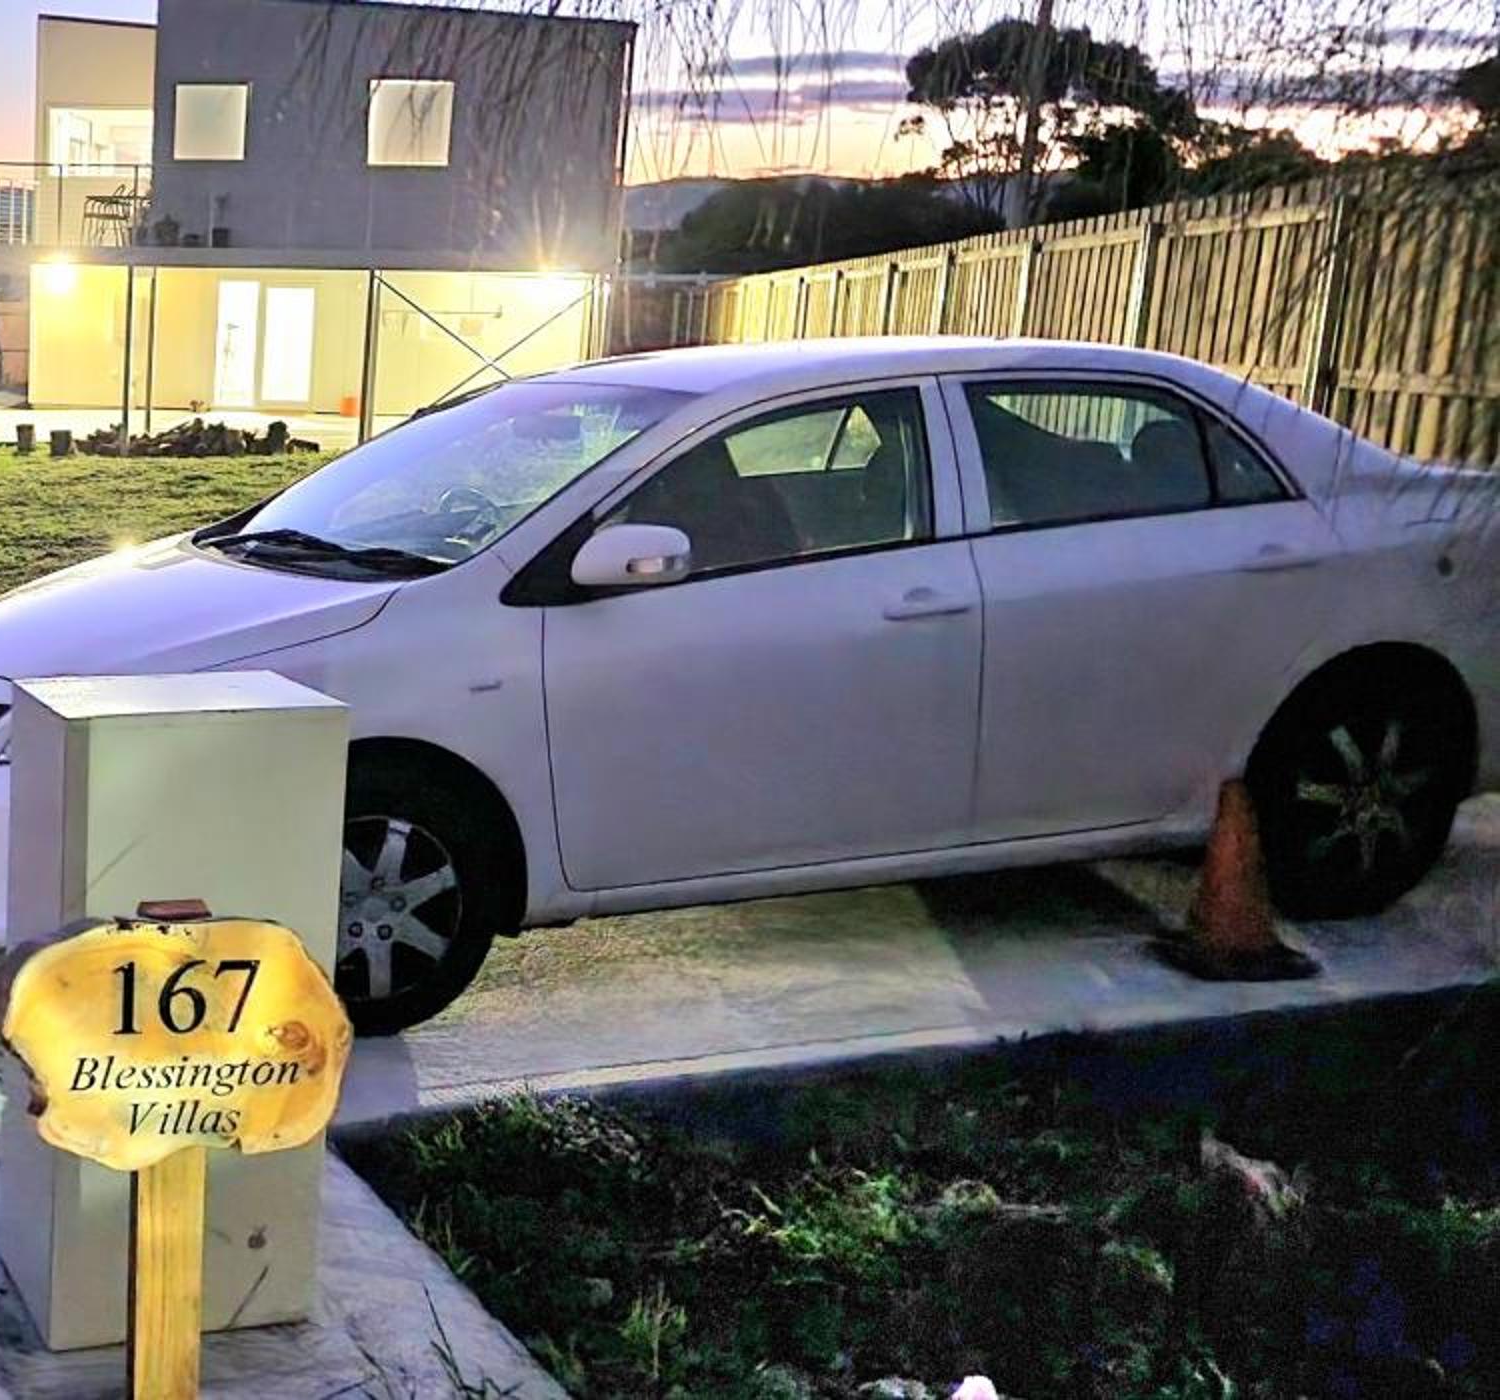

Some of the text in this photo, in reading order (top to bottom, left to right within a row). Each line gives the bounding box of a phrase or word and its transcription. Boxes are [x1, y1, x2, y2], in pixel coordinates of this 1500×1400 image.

[112, 960, 261, 1035] 167
[70, 1056, 300, 1096] Blessington
[129, 1100, 241, 1135] Villas
